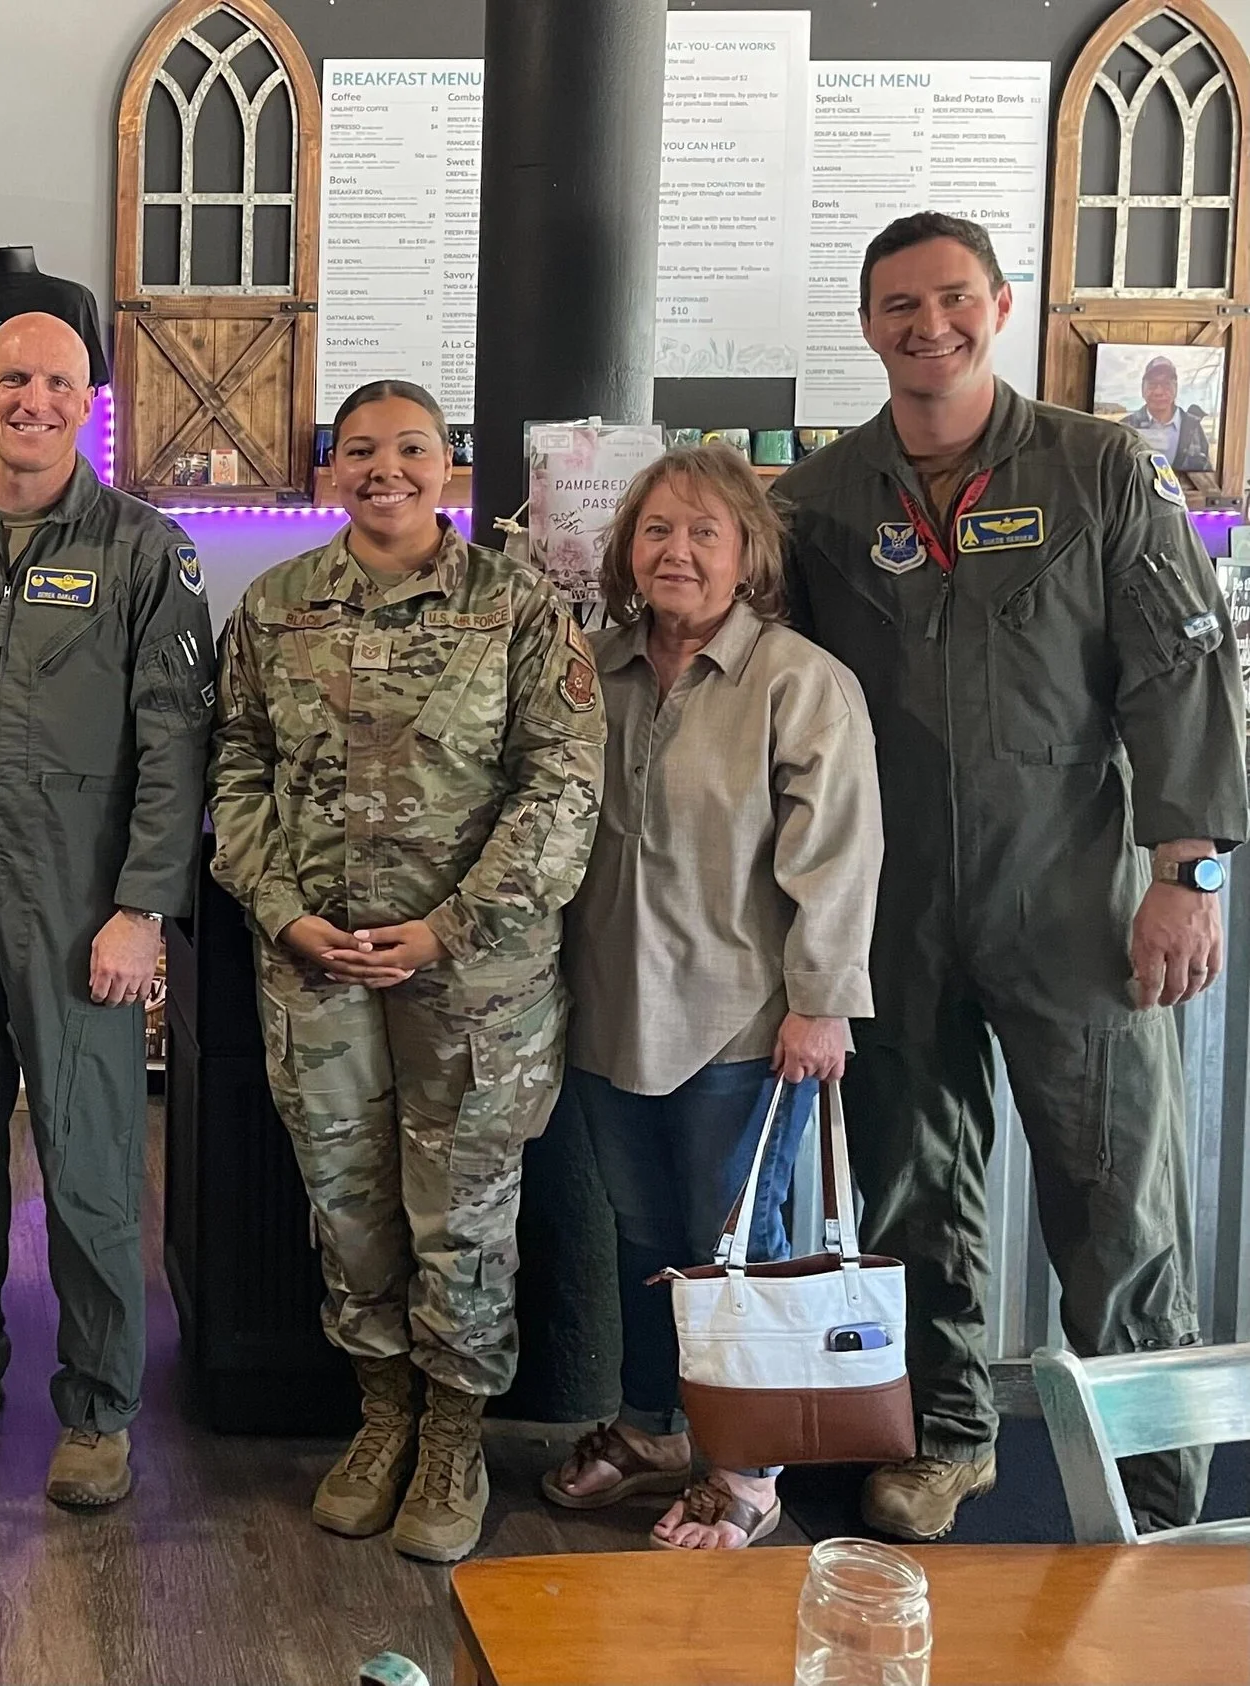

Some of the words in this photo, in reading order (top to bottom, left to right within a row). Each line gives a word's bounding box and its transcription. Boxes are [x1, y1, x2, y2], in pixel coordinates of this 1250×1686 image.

[739, 42, 776, 51] WORKS
[332, 72, 427, 86] BREAKFAST
[431, 72, 482, 86] MENU
[817, 74, 875, 87] LUNCH
[880, 74, 931, 87] MENU
[331, 92, 362, 102] Coffee
[816, 94, 852, 104] Specials
[933, 94, 962, 103] Baked
[964, 94, 994, 103] Potato
[997, 94, 1024, 103] Bowls
[663, 142, 685, 150] YOU
[687, 142, 709, 150] CAN
[711, 142, 736, 150] HELP
[446, 157, 475, 166] Sweet
[329, 176, 357, 184] Bowls
[812, 200, 840, 208] Bowls
[971, 210, 978, 218] &
[980, 210, 1010, 218] Drinks
[444, 271, 474, 280] Savory
[671, 306, 689, 316] $10
[326, 338, 380, 346] Sandwiches
[555, 480, 627, 491] PAMPERED
[582, 499, 619, 509] PASS
[428, 612, 449, 625] U.S.
[453, 613, 471, 626] AIR
[473, 611, 509, 628] FORCE
